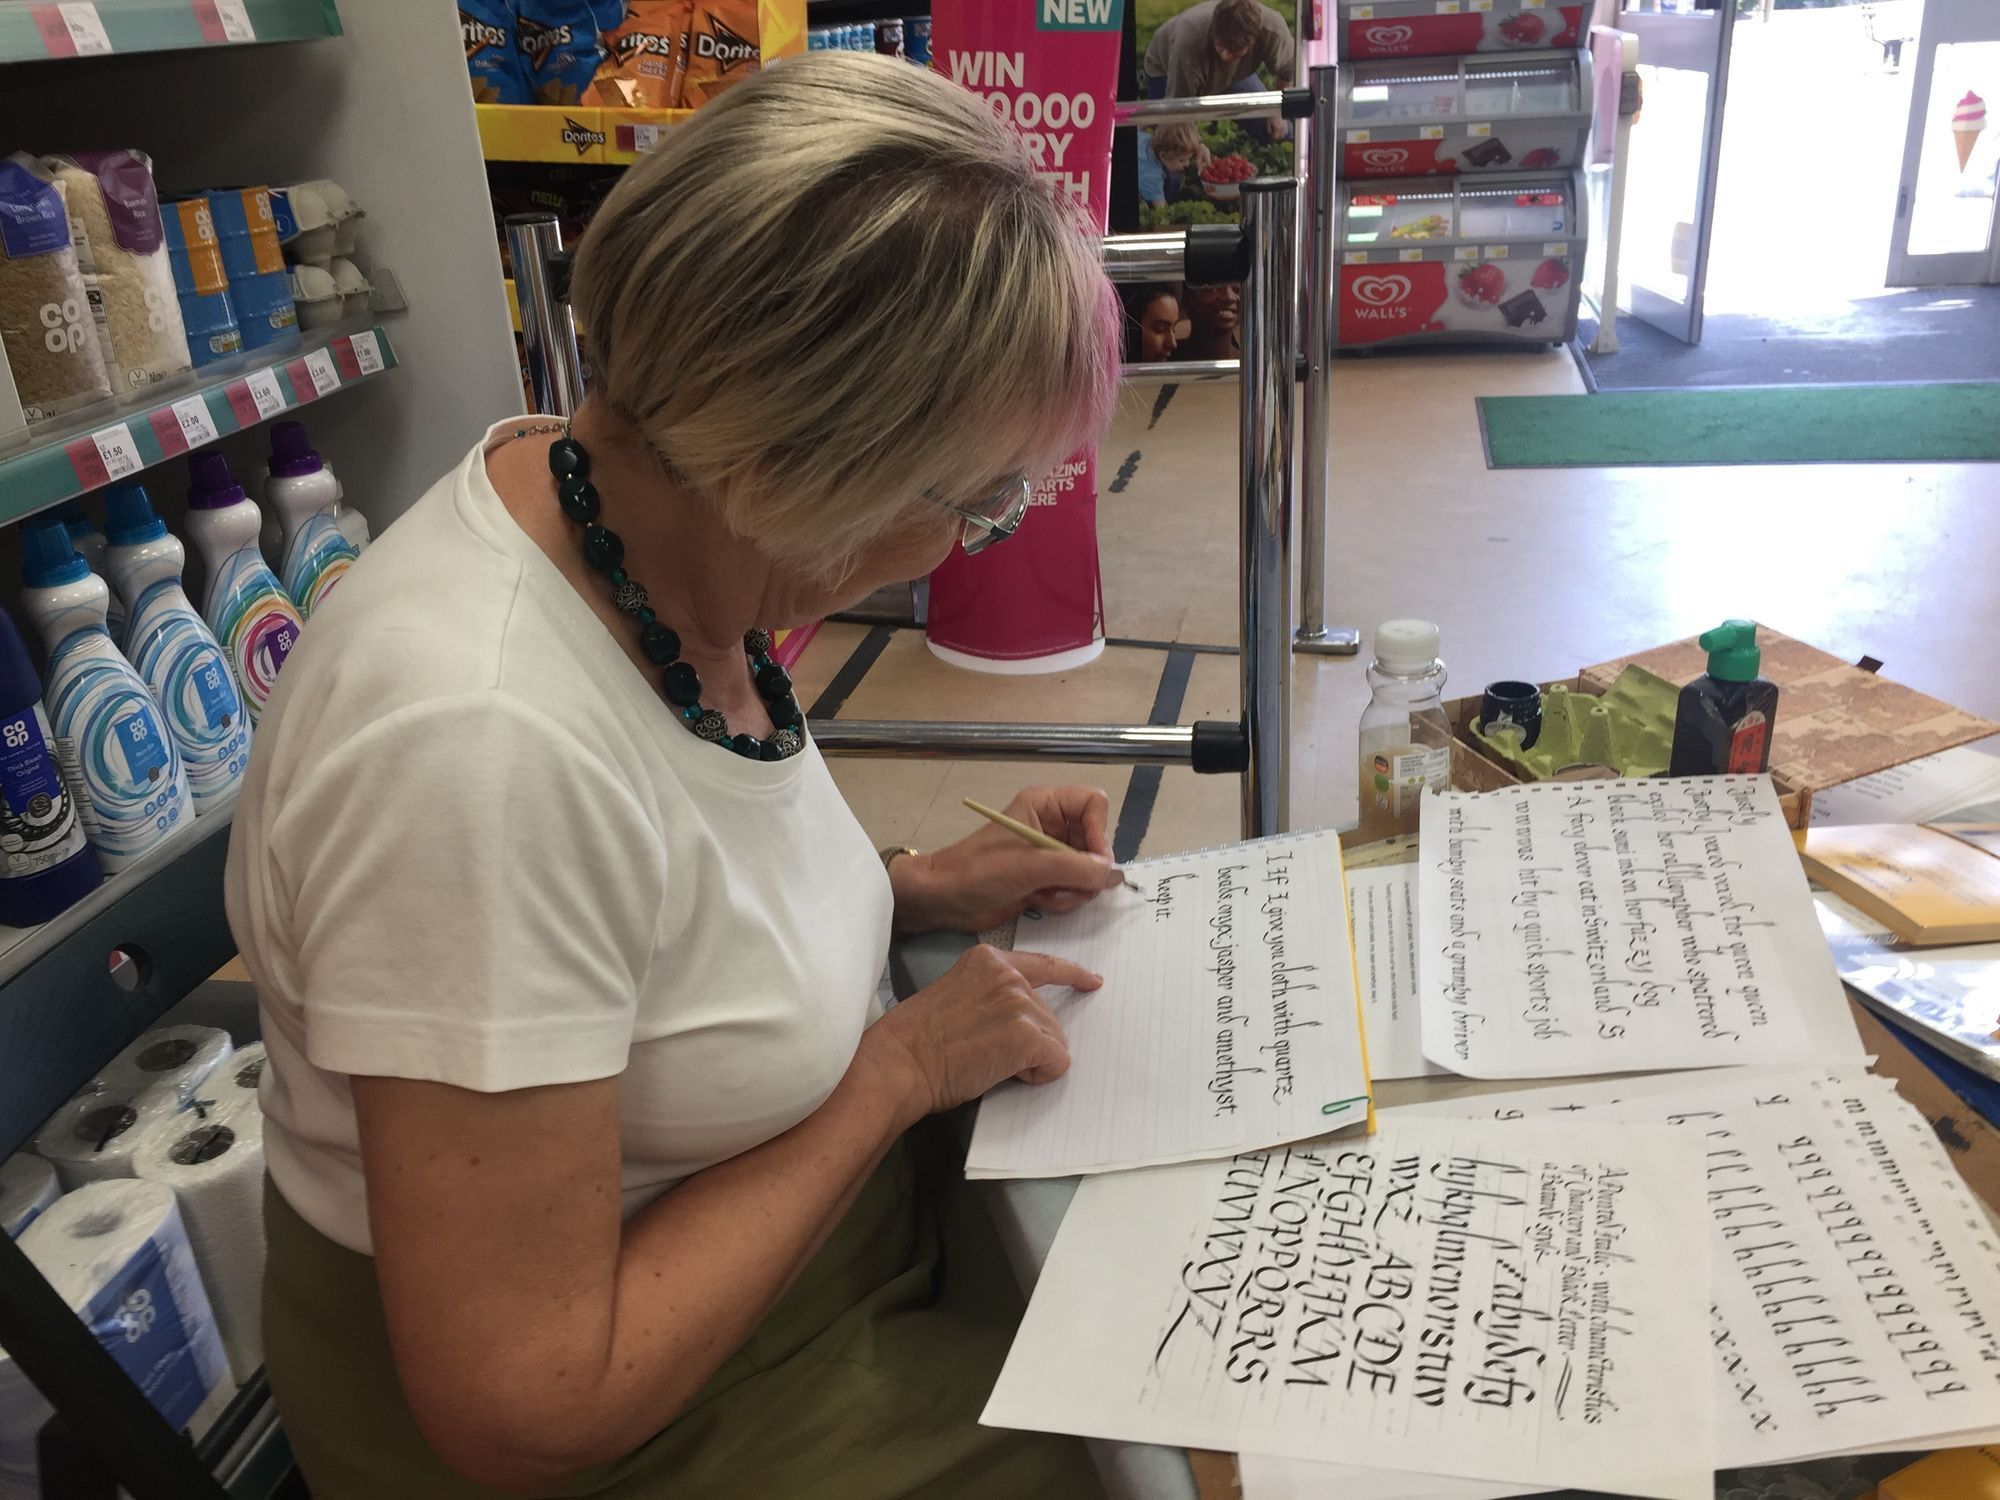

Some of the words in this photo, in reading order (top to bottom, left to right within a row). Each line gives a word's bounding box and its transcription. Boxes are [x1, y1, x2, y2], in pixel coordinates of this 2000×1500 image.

[1043, 0, 1111, 24] NEW
[462, 20, 505, 46] ritos
[621, 32, 670, 54] ritos
[949, 50, 1024, 88] WIN
[564, 131, 604, 145] Doritos
[1023, 133, 1074, 167] RY
[1354, 306, 1408, 320] WALL'S
[181, 415, 199, 429] £2.00
[103, 446, 123, 460] £1.50
[1034, 477, 1075, 492] ARTS
[1029, 492, 1058, 506] ERE
[7, 763, 24, 773] Thick
[24, 754, 42, 766] Bleach
[16, 762, 40, 777] Original
[1568, 797, 1592, 808] A
[1574, 841, 1611, 877] clever
[1262, 867, 1289, 885] If
[1519, 867, 1563, 887] hit
[1622, 879, 1638, 893] on
[1146, 874, 1199, 905] keep
[1268, 892, 1289, 903] I
[1450, 878, 1467, 911] seats
[1512, 890, 1559, 908] by
[1579, 881, 1598, 902] cat
[1261, 903, 1287, 931] give
[1523, 911, 1540, 919] a
[1625, 899, 1671, 919] her
[1450, 913, 1481, 941] and
[1723, 916, 1776, 936] the
[1263, 931, 1284, 960] you
[1451, 941, 1466, 949] a
[1513, 923, 1577, 960] quick
[1682, 936, 1724, 964] who
[1205, 939, 1239, 990] jasper
[1272, 962, 1320, 1000] cloth
[1516, 963, 1552, 1012] sports
[1633, 981, 1676, 1008] dog
[1217, 996, 1249, 1027] and
[1273, 1001, 1323, 1037] with
[1452, 1011, 1487, 1060] driver
[1260, 1040, 1295, 1105] quartz
[1565, 1237, 1591, 1264] and
[1592, 1281, 1634, 1315] with
